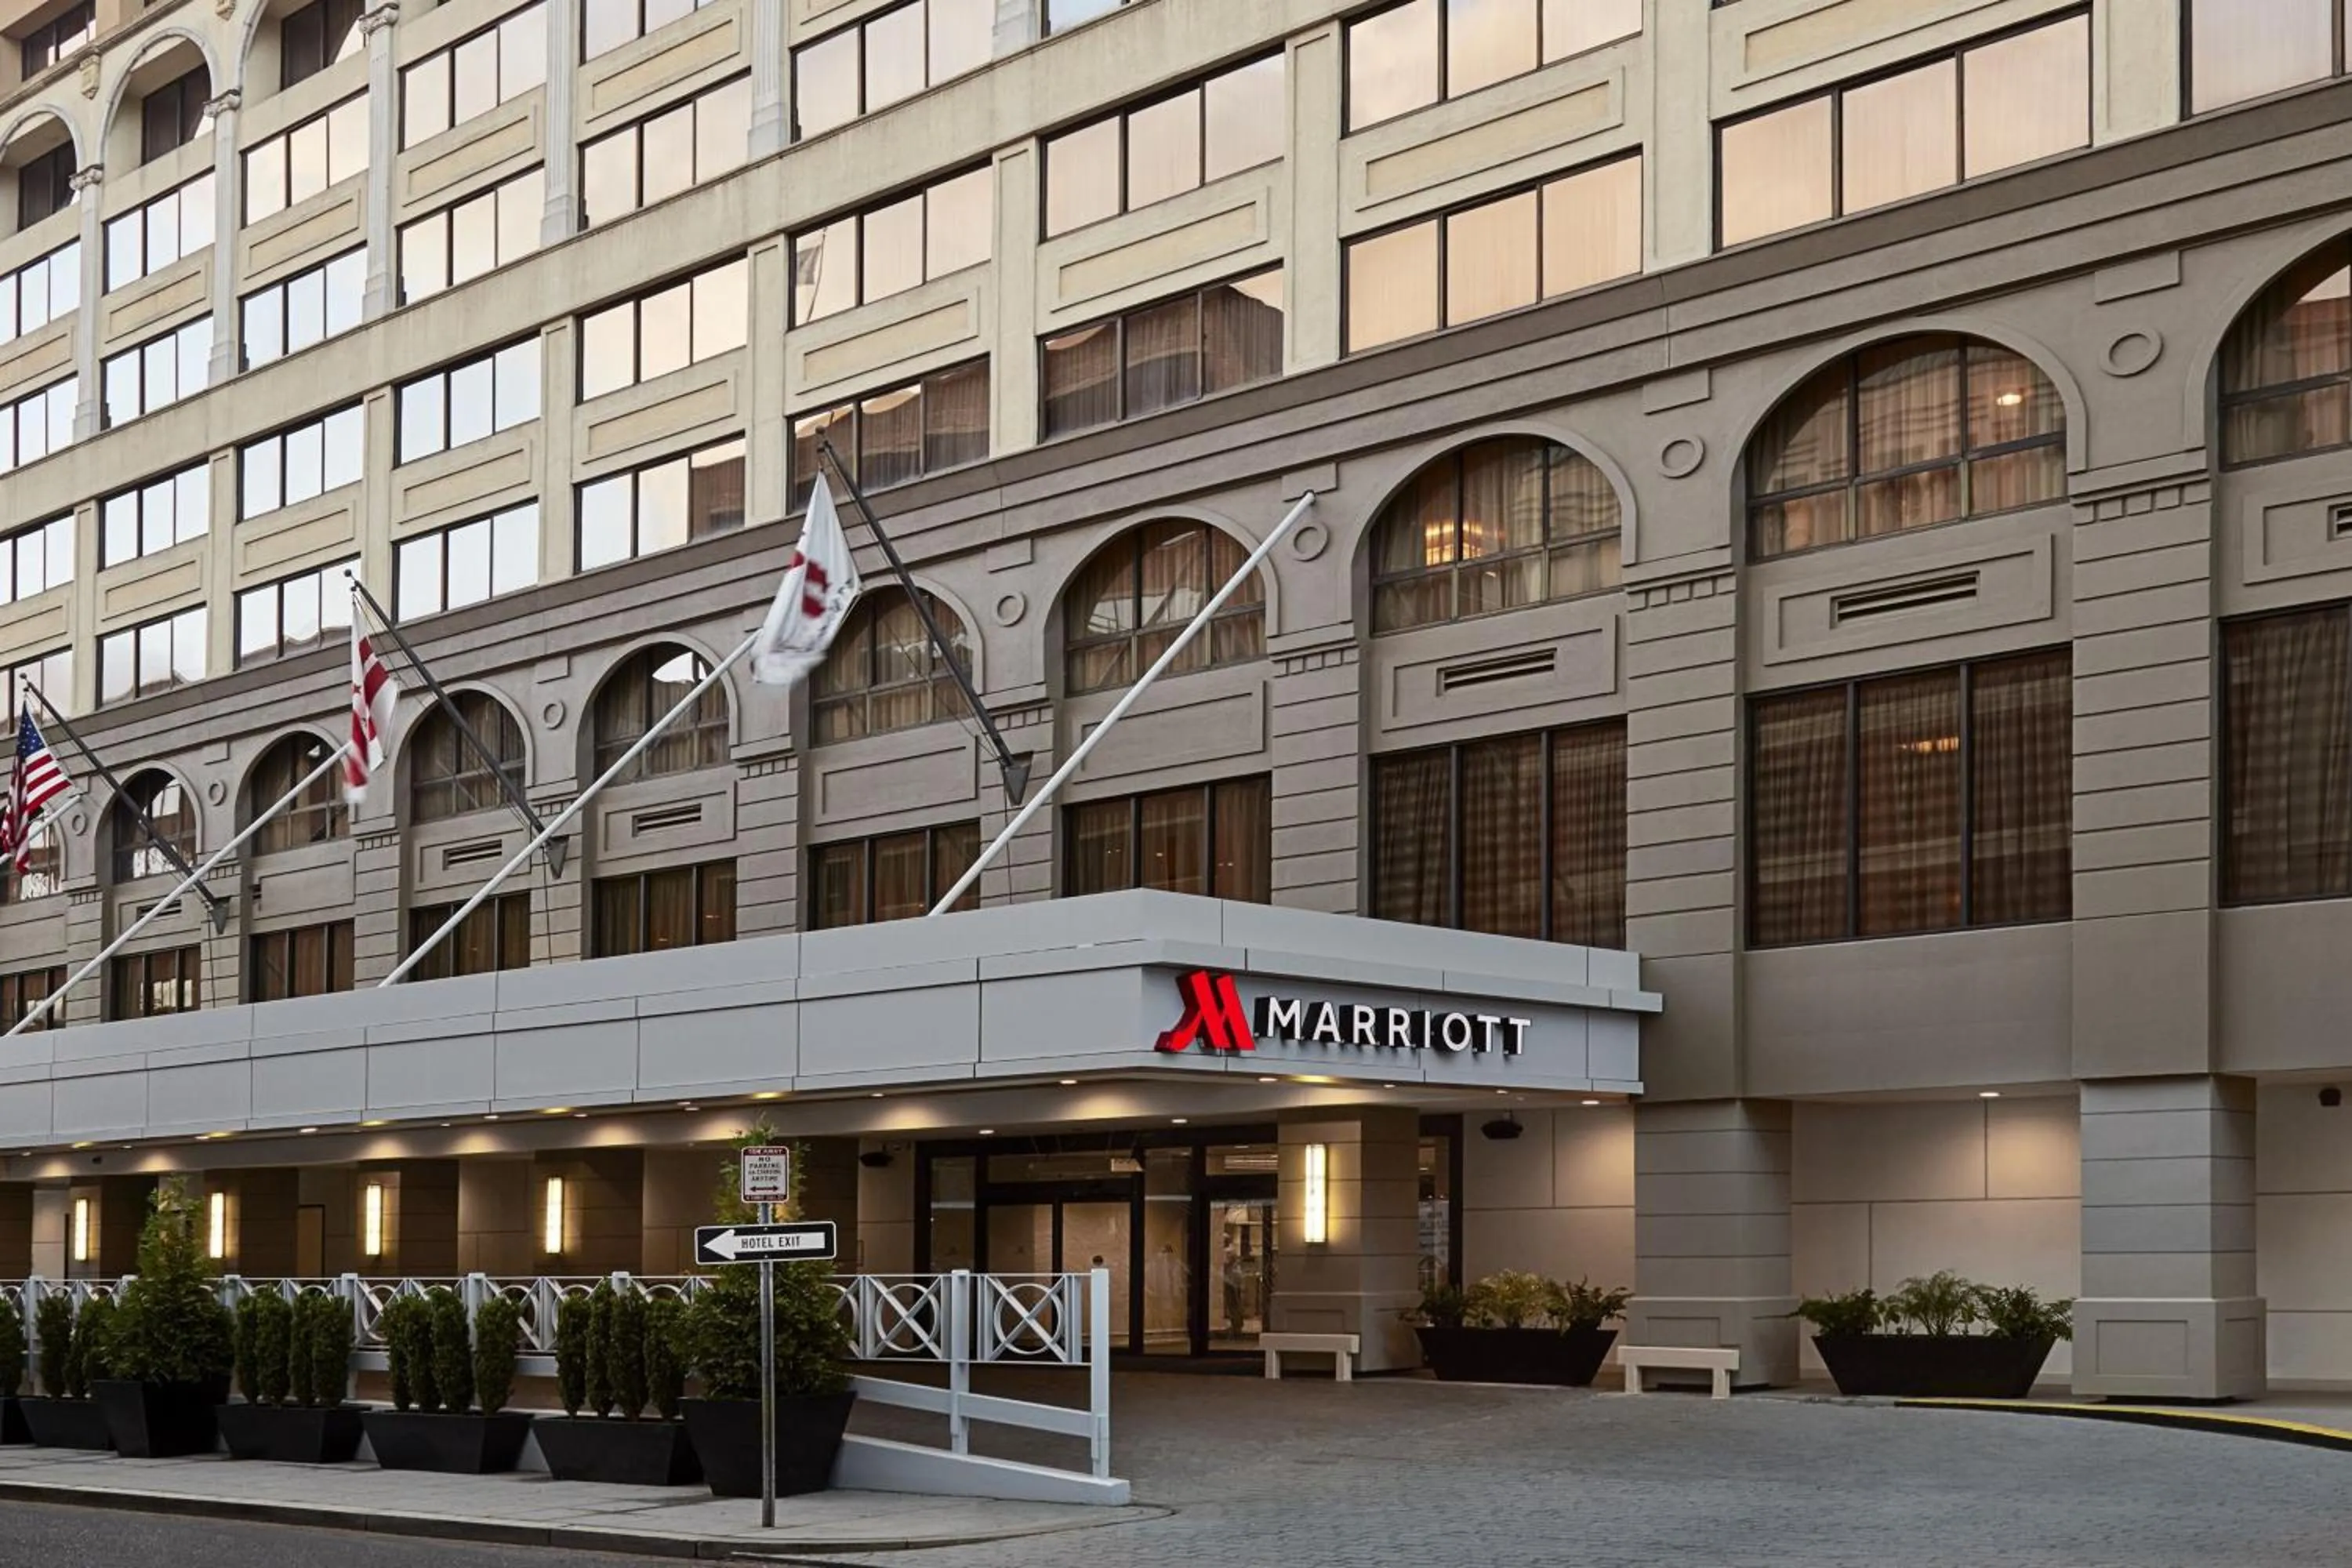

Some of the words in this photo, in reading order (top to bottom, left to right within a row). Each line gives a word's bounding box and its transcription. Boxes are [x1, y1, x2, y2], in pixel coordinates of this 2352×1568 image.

[1264, 996, 1531, 1055] MARRIOTT
[741, 1236, 775, 1249] HOTEL
[779, 1235, 800, 1247] EXIT
